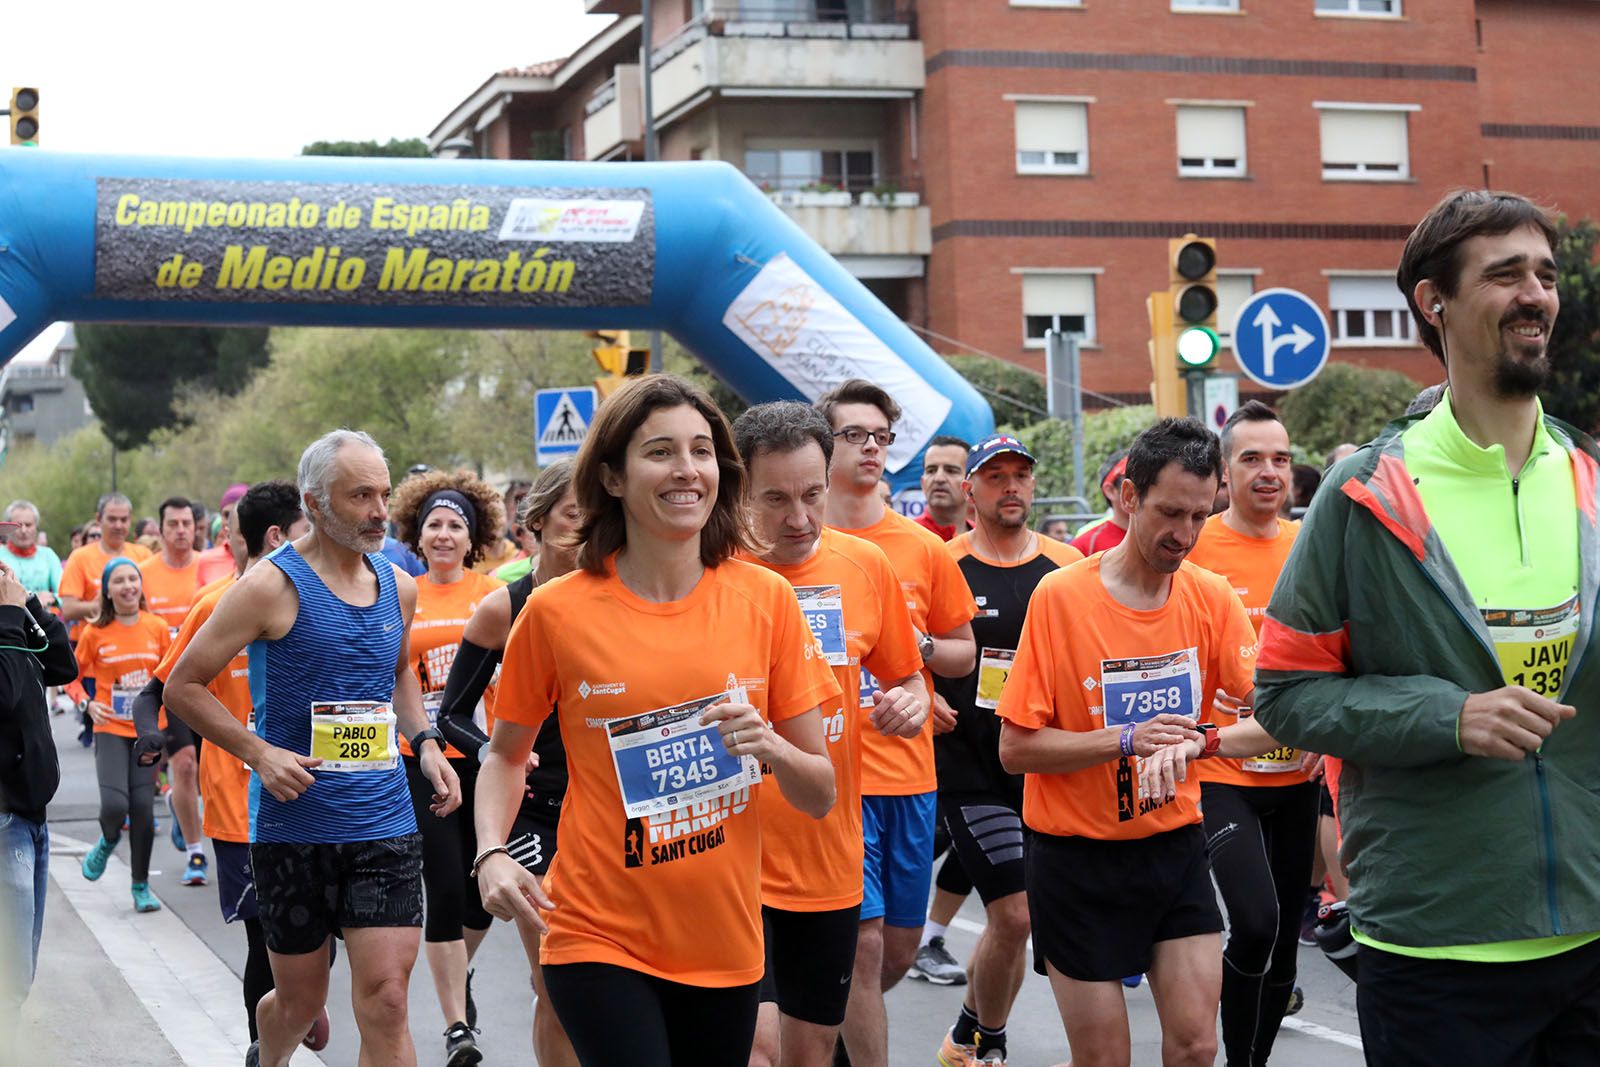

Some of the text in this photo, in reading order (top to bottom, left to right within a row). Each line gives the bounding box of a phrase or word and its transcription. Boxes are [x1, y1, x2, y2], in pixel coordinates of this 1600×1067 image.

[115, 193, 321, 234] Campeonato
[326, 200, 363, 229] de
[370, 197, 491, 237] España
[156, 244, 576, 293] de Medio Maratón
[1523, 640, 1568, 668] JAVI
[1512, 668, 1568, 696] 133
[1121, 687, 1181, 715] 7358
[333, 726, 377, 740] PABLO
[339, 743, 370, 759] 289
[645, 734, 714, 769] BERTA
[1256, 747, 1294, 761] 313
[652, 756, 718, 793] 7345
[651, 838, 687, 866] SANT
[688, 825, 726, 856] CUGAT
